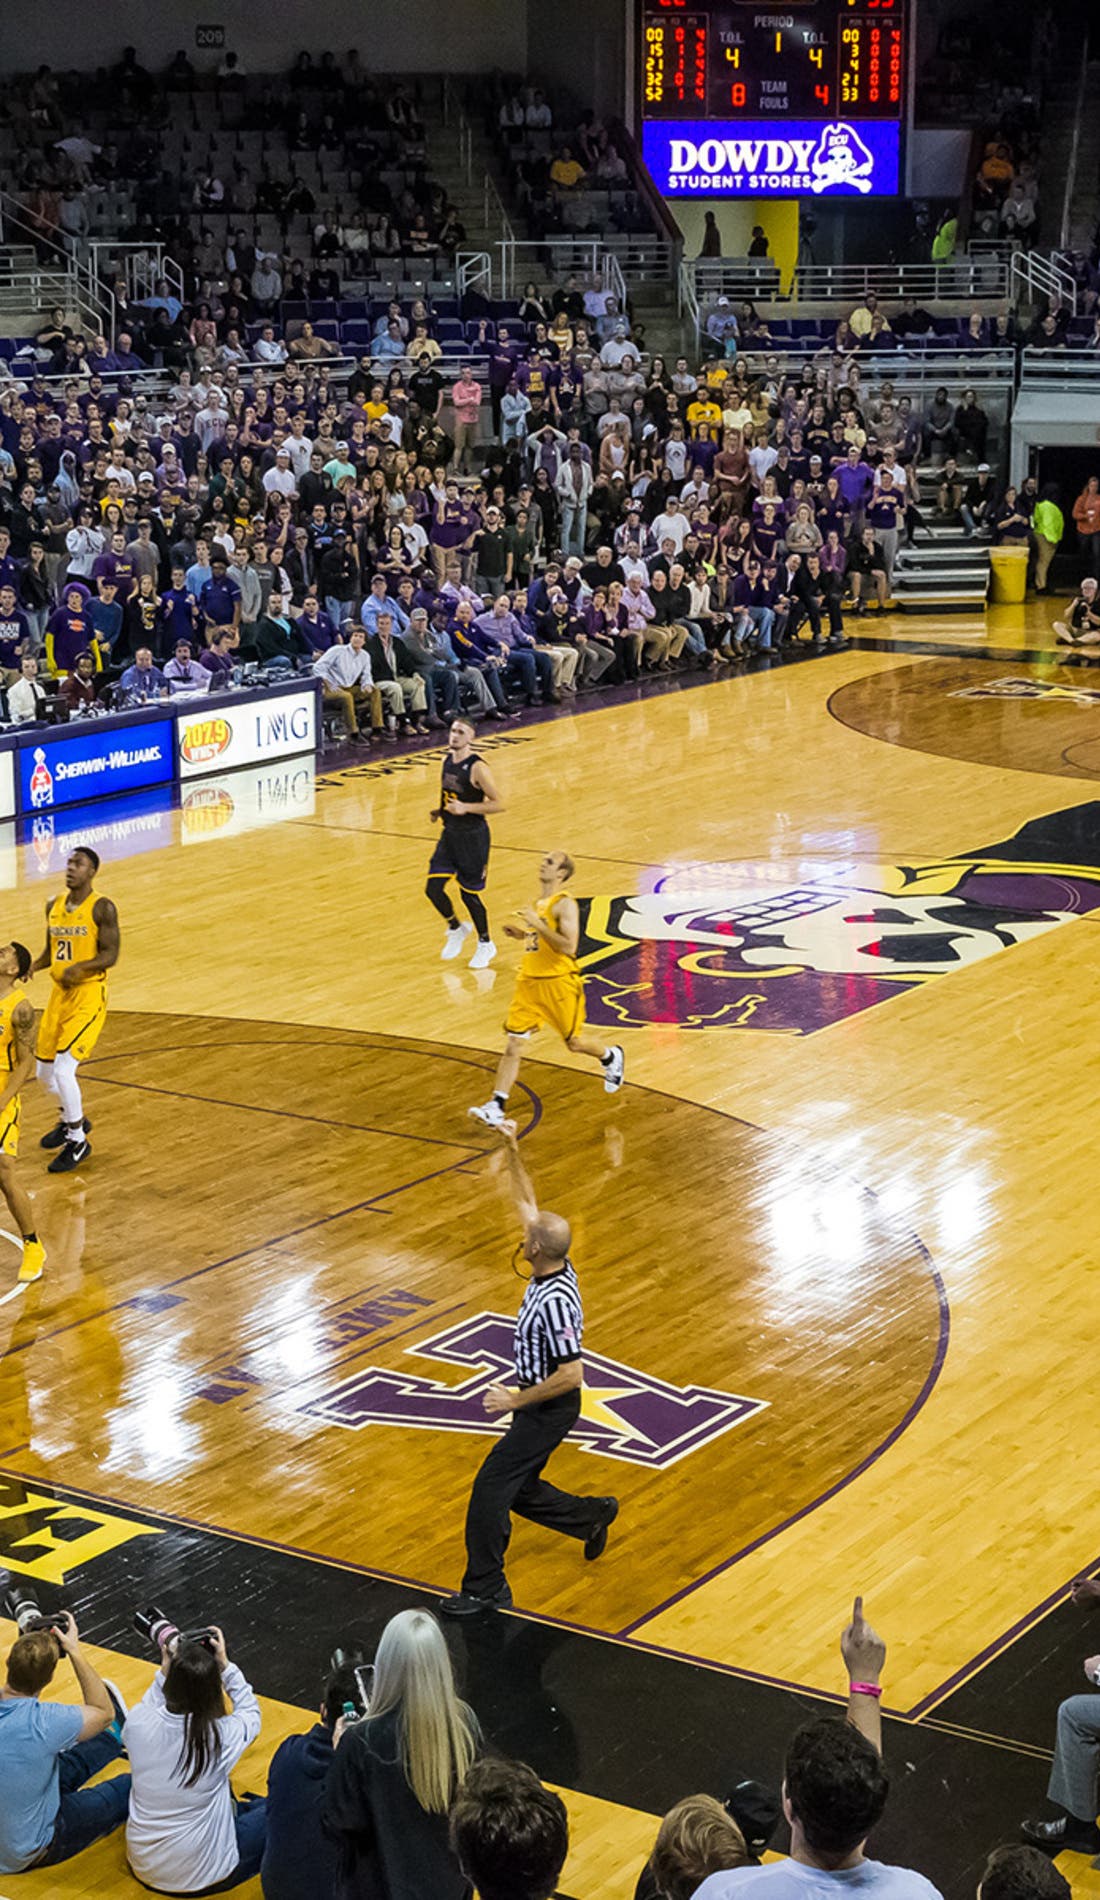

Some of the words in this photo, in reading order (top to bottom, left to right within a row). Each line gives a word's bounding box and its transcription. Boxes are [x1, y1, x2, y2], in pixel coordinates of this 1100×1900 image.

[754, 15, 794, 28] PERIOD
[197, 30, 223, 44] 209
[646, 27, 664, 42] 00
[842, 28, 860, 43] 00
[870, 28, 880, 43] 0
[649, 42, 664, 57] 15
[775, 32, 782, 53] 1
[725, 47, 740, 69] 4
[808, 47, 823, 69] 4
[851, 43, 859, 58] 3
[870, 43, 880, 57] 0
[890, 43, 900, 58] 0
[645, 57, 664, 71] 21
[850, 59, 859, 72] 4
[870, 58, 880, 72] 0
[890, 58, 900, 72] 0
[646, 72, 664, 86] 32
[674, 72, 685, 86] 0
[842, 72, 859, 87] 21
[869, 73, 879, 87] 0
[890, 73, 899, 87] 0
[731, 82, 747, 107] 8
[761, 81, 788, 93] TEAM
[842, 87, 859, 102] 33
[869, 87, 879, 102] 0
[814, 84, 829, 106] 4
[759, 97, 789, 109] FOULS
[828, 134, 849, 147] ECU
[669, 139, 817, 173] DOWDY
[668, 174, 744, 189] STUDENT
[749, 174, 812, 189] STORES
[256, 707, 308, 747] IMG
[56, 939, 72, 961] 21
